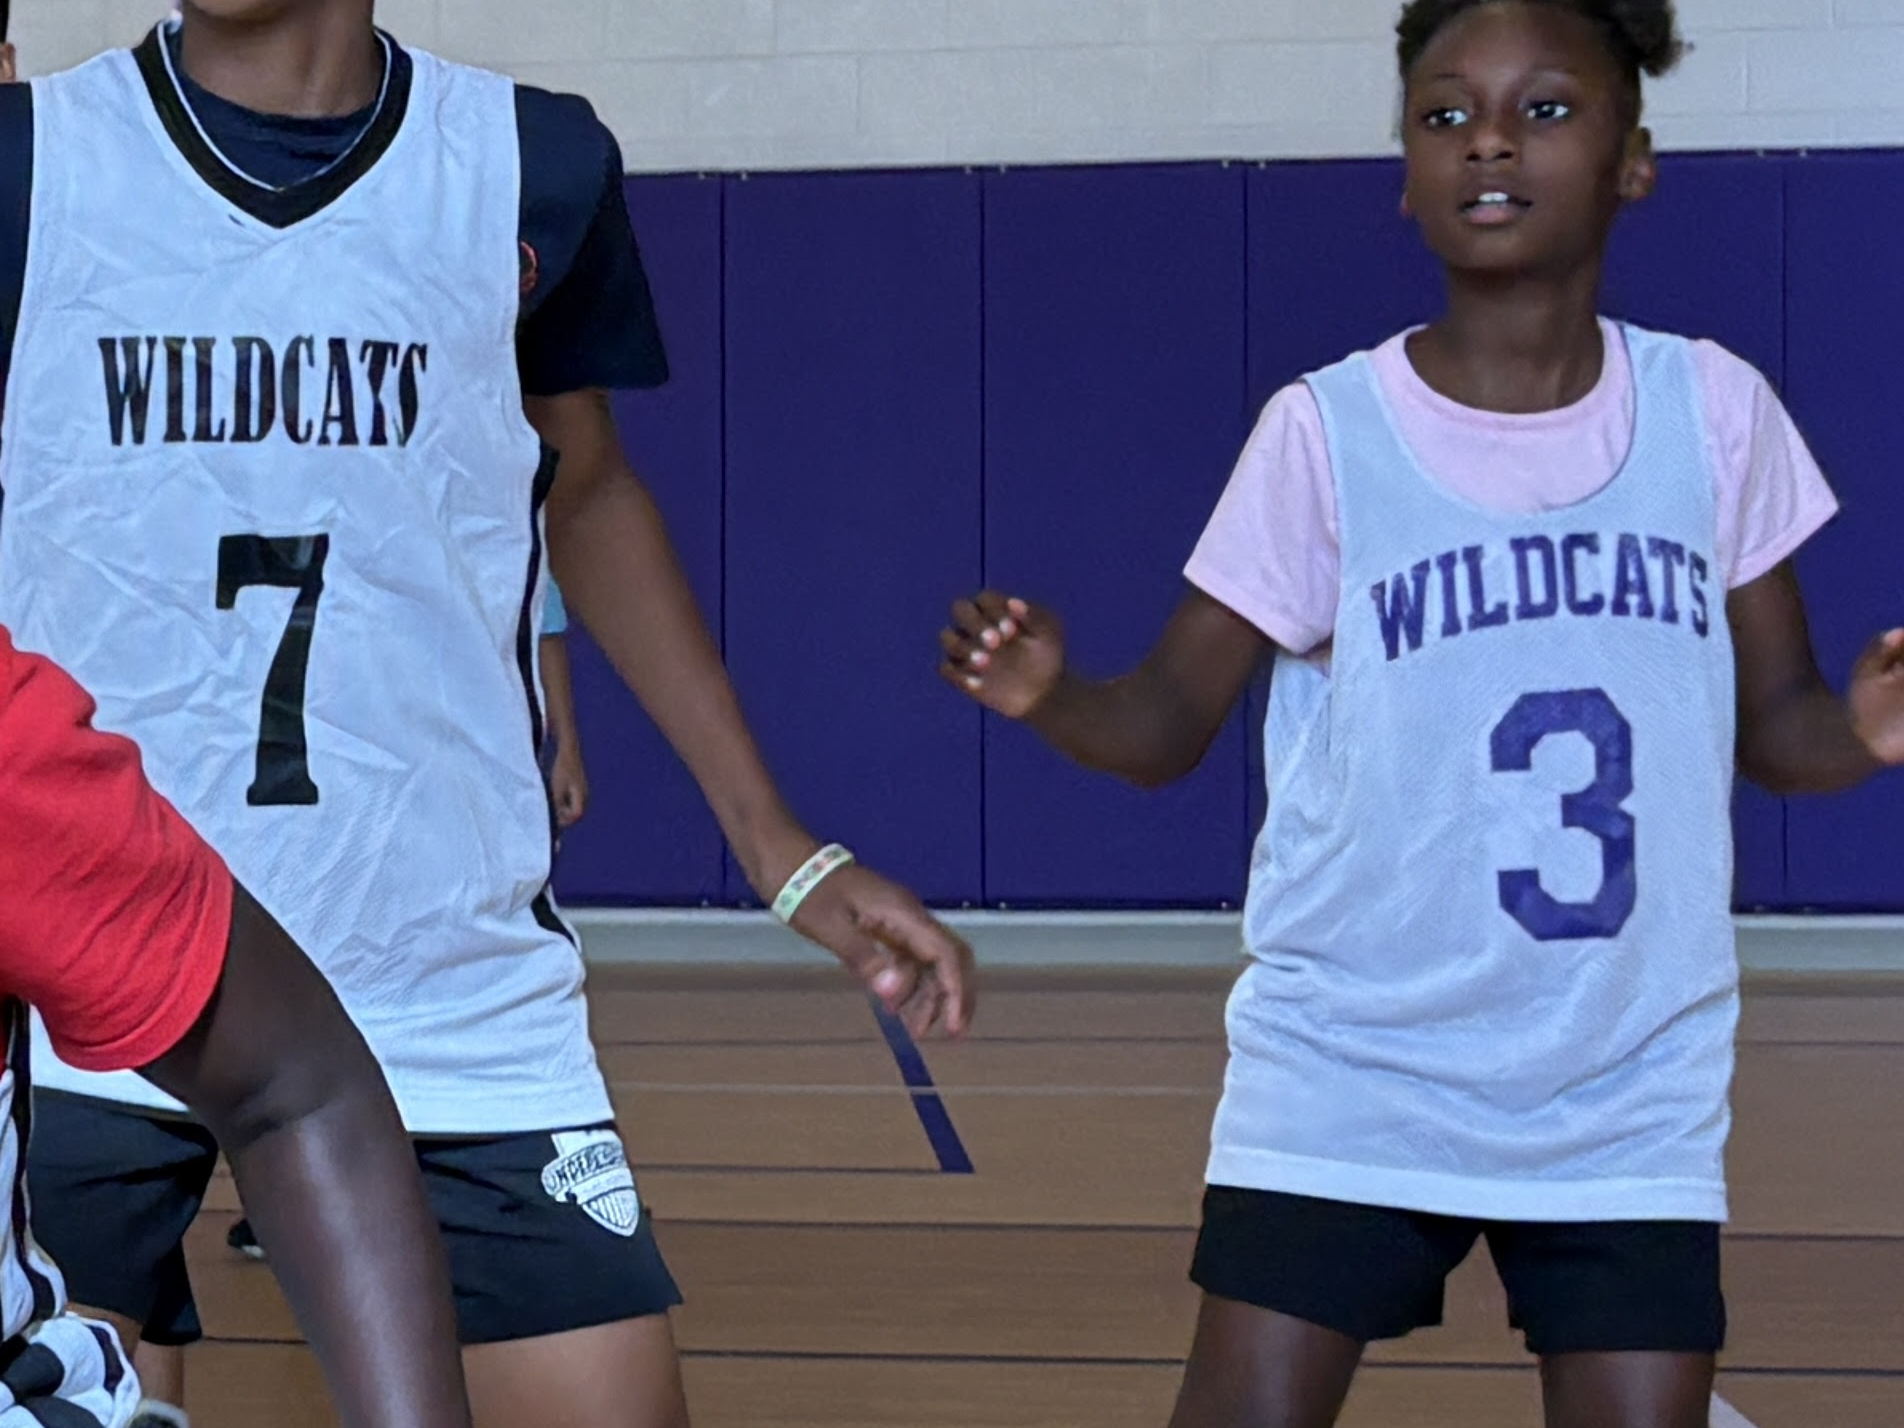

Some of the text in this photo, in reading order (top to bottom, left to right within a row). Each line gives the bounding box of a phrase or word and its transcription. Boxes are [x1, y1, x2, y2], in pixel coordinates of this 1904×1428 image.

[97, 335, 428, 449] WILDCATS
[215, 533, 330, 807] 7
[1370, 532, 1709, 662] WILDCATS
[1489, 687, 1637, 942] 3
